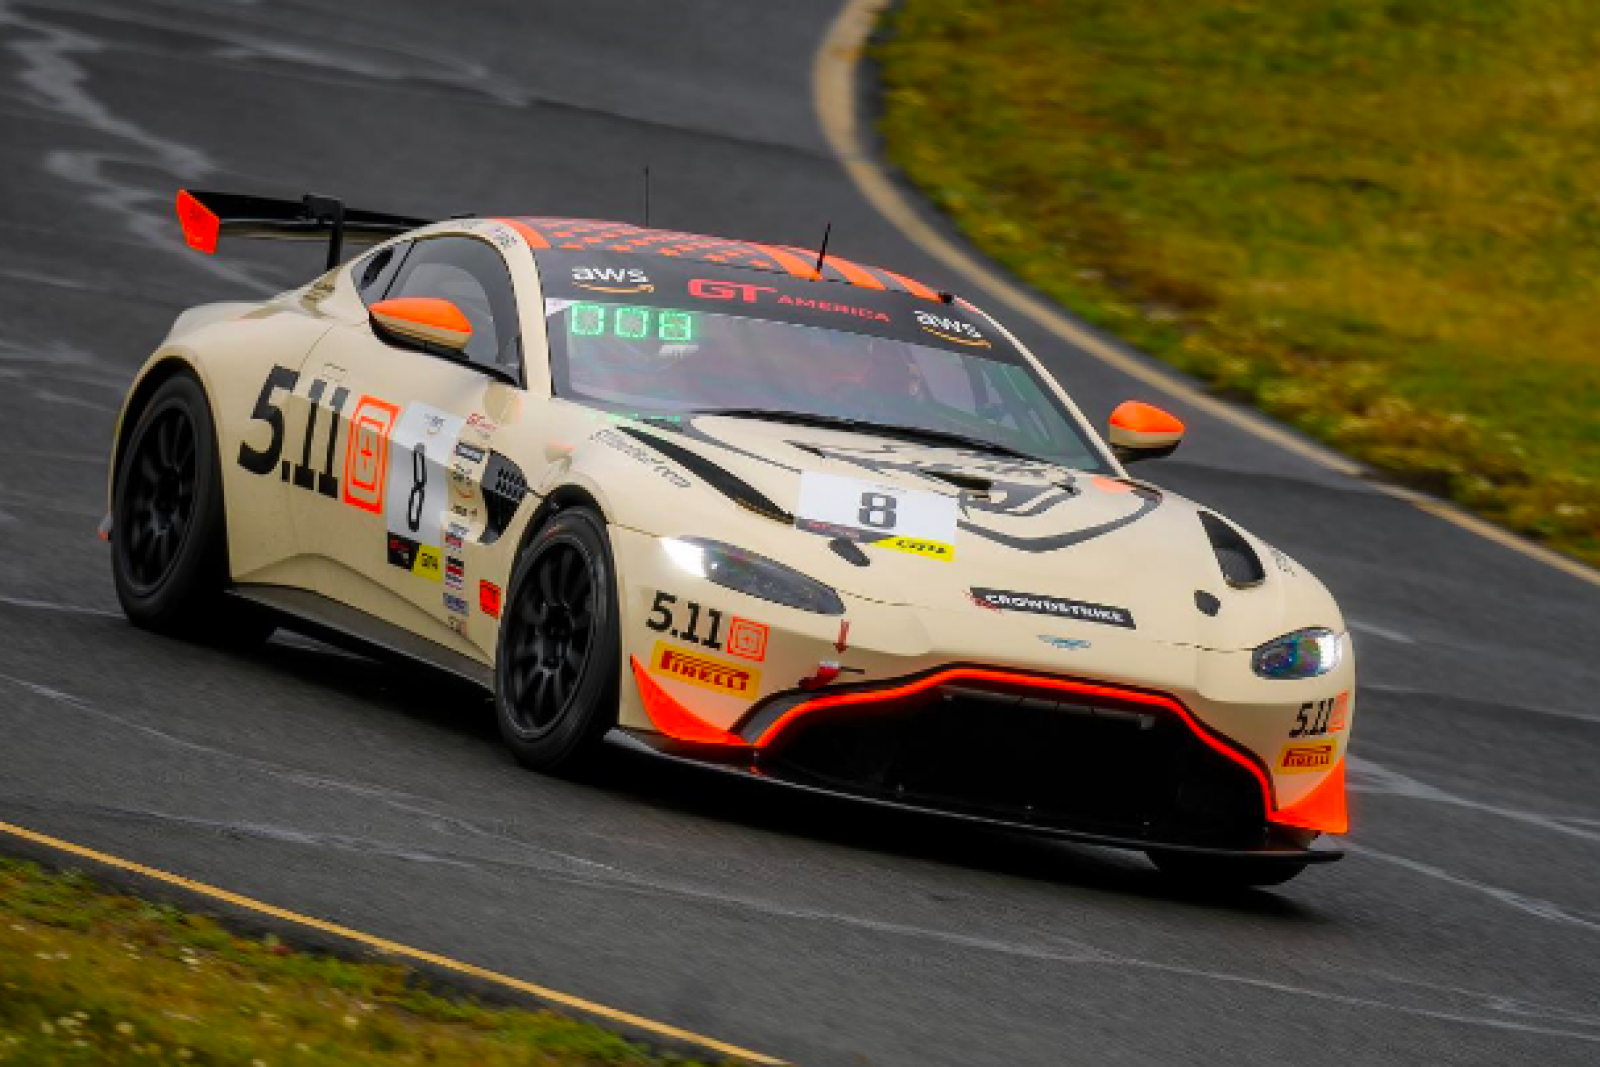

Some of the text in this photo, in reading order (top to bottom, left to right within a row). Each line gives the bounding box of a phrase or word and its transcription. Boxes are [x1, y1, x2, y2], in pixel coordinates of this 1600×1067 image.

[572, 266, 648, 283] aws
[687, 278, 891, 322] GT AMERICA
[914, 309, 983, 338] aws
[237, 363, 350, 500] 5.11
[407, 442, 427, 532] 8
[859, 492, 897, 529] 8
[646, 590, 722, 651] 5.11
[660, 650, 749, 691] PIRELLI
[1288, 697, 1334, 738] 5.11
[1282, 745, 1332, 768] PIRELLI
